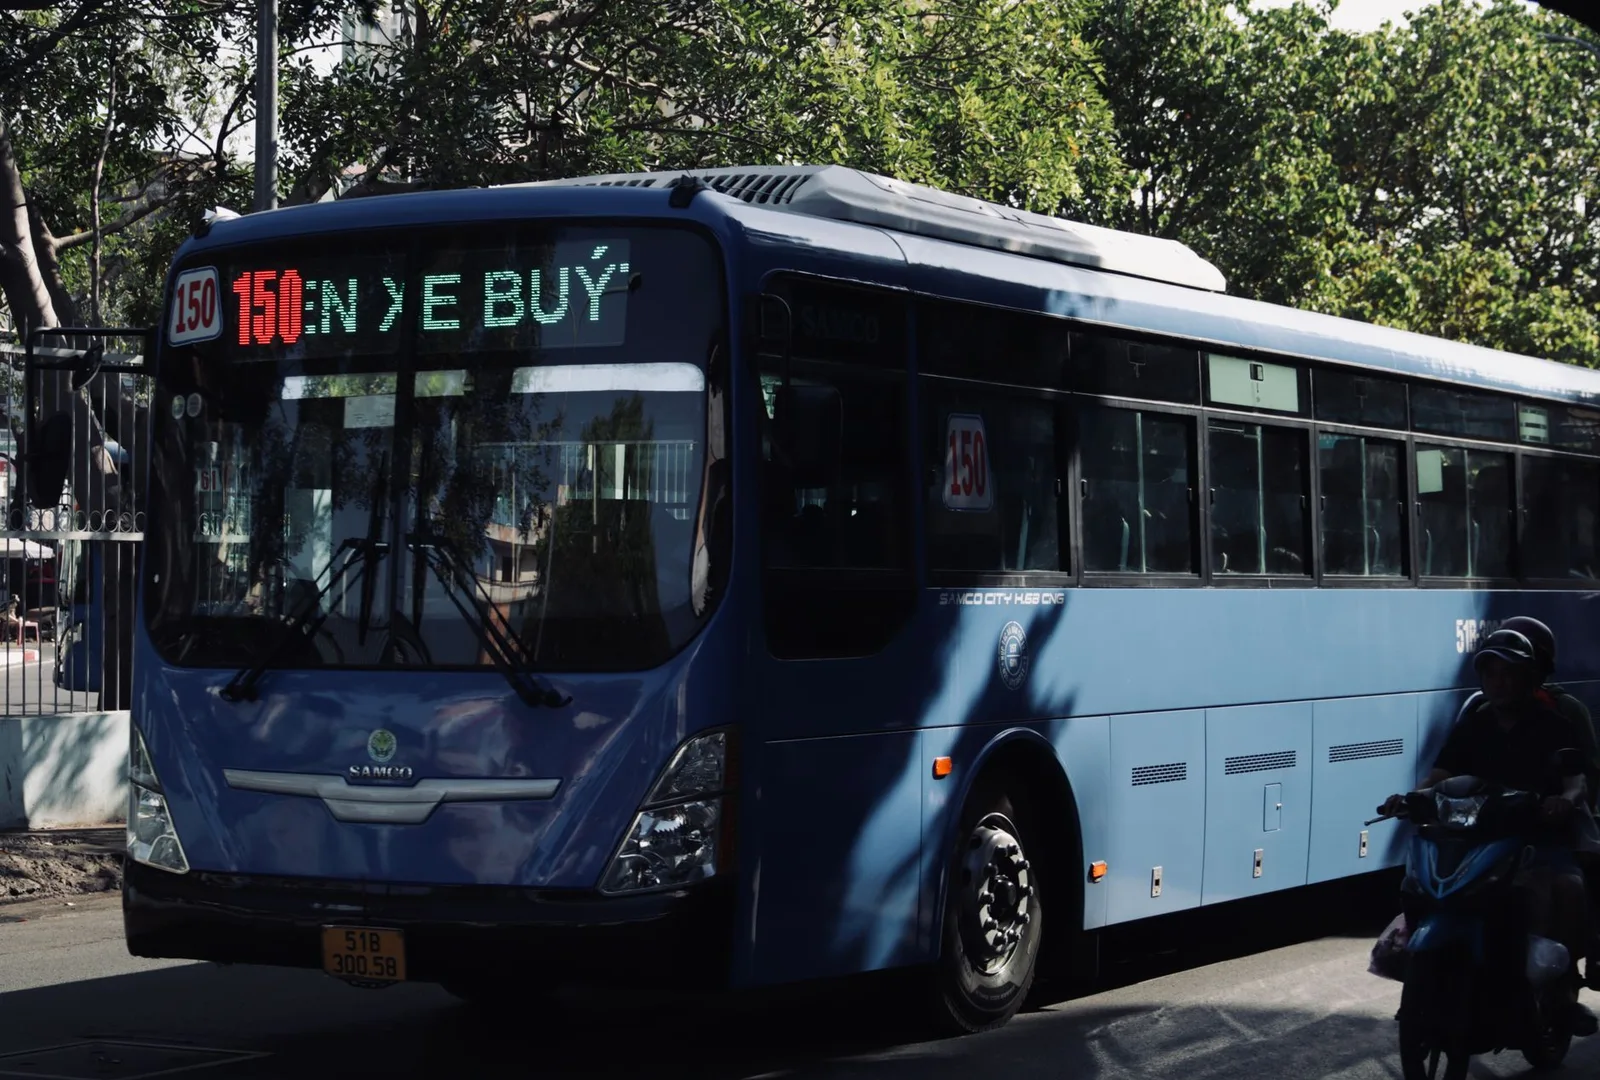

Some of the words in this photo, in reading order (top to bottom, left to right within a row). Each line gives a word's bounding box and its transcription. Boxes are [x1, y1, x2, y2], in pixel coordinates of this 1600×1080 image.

[176, 278, 215, 333] 150
[484, 246, 630, 327] BUÝ
[233, 269, 302, 345] 150
[950, 430, 986, 496] 150
[939, 593, 984, 605] SAMCO
[984, 593, 1012, 605] CITY
[1041, 593, 1064, 605] CNG
[349, 765, 413, 779] SAMCO
[344, 931, 380, 952] 51B
[332, 954, 397, 977] 300.58
